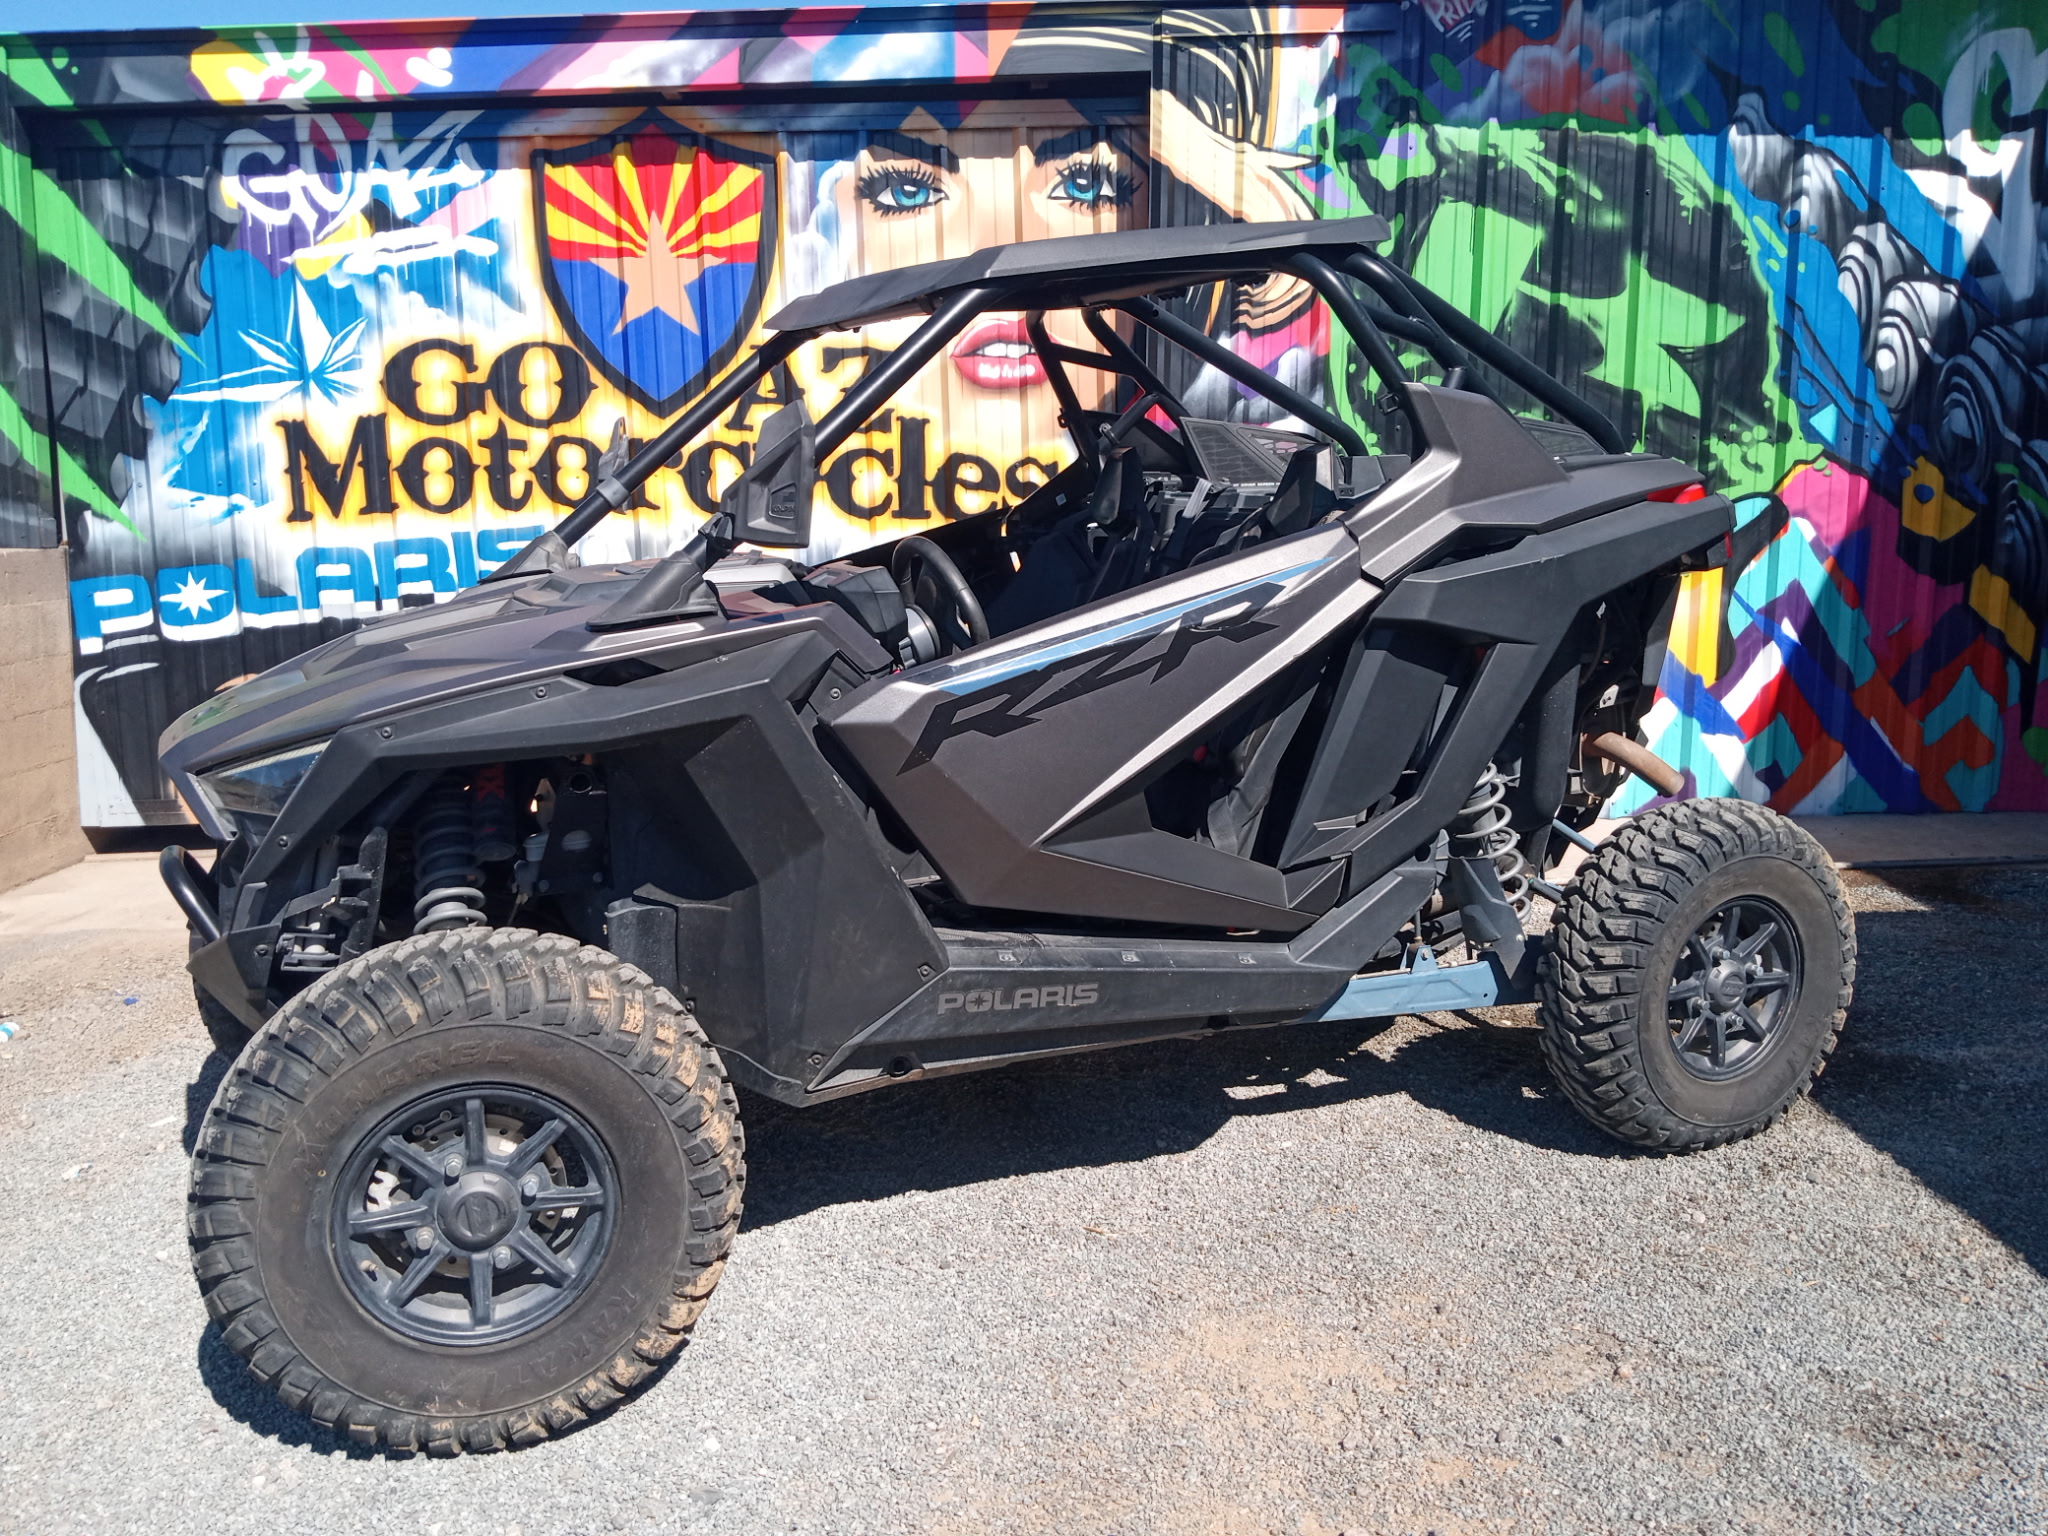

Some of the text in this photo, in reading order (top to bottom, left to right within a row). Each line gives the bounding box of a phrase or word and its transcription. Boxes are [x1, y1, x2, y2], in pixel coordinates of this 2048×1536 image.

[380, 338, 598, 428] GO
[275, 412, 1059, 522] Motorccles
[896, 581, 1286, 776] RZR
[937, 983, 1098, 1015] POLARIS
